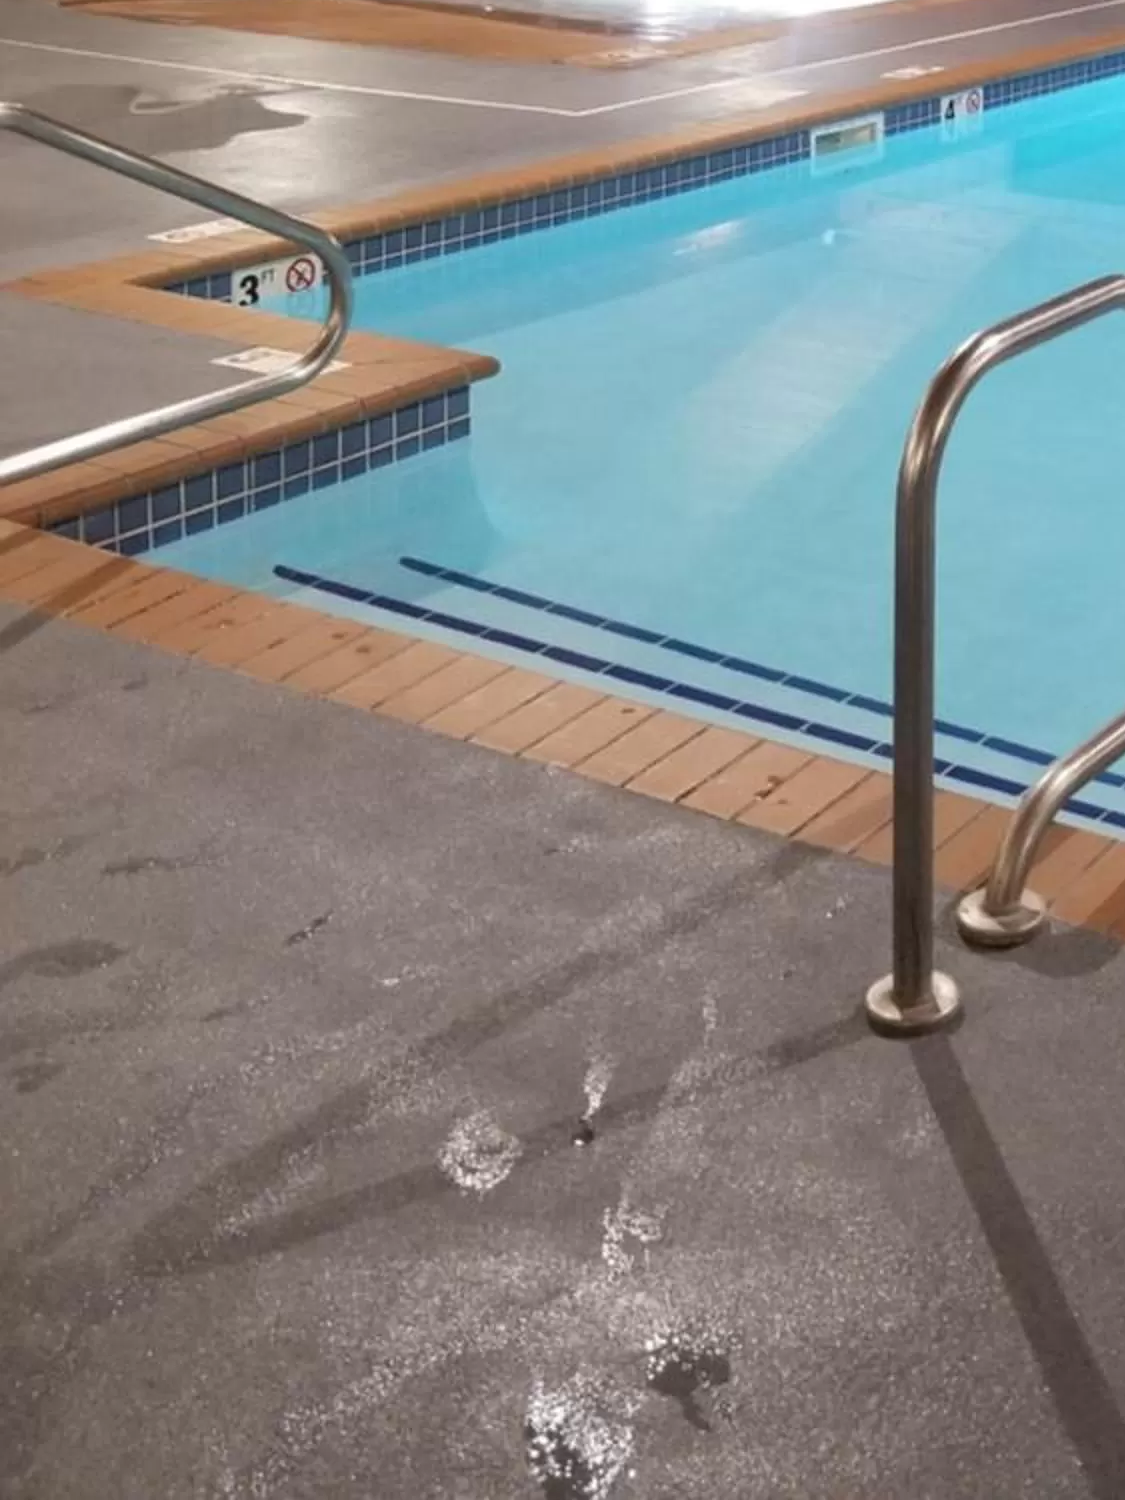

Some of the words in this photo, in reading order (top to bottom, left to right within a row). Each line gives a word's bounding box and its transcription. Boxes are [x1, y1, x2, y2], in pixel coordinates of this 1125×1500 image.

[944, 99, 955, 120] 4
[238, 273, 260, 307] 3
[261, 267, 275, 285] FT
